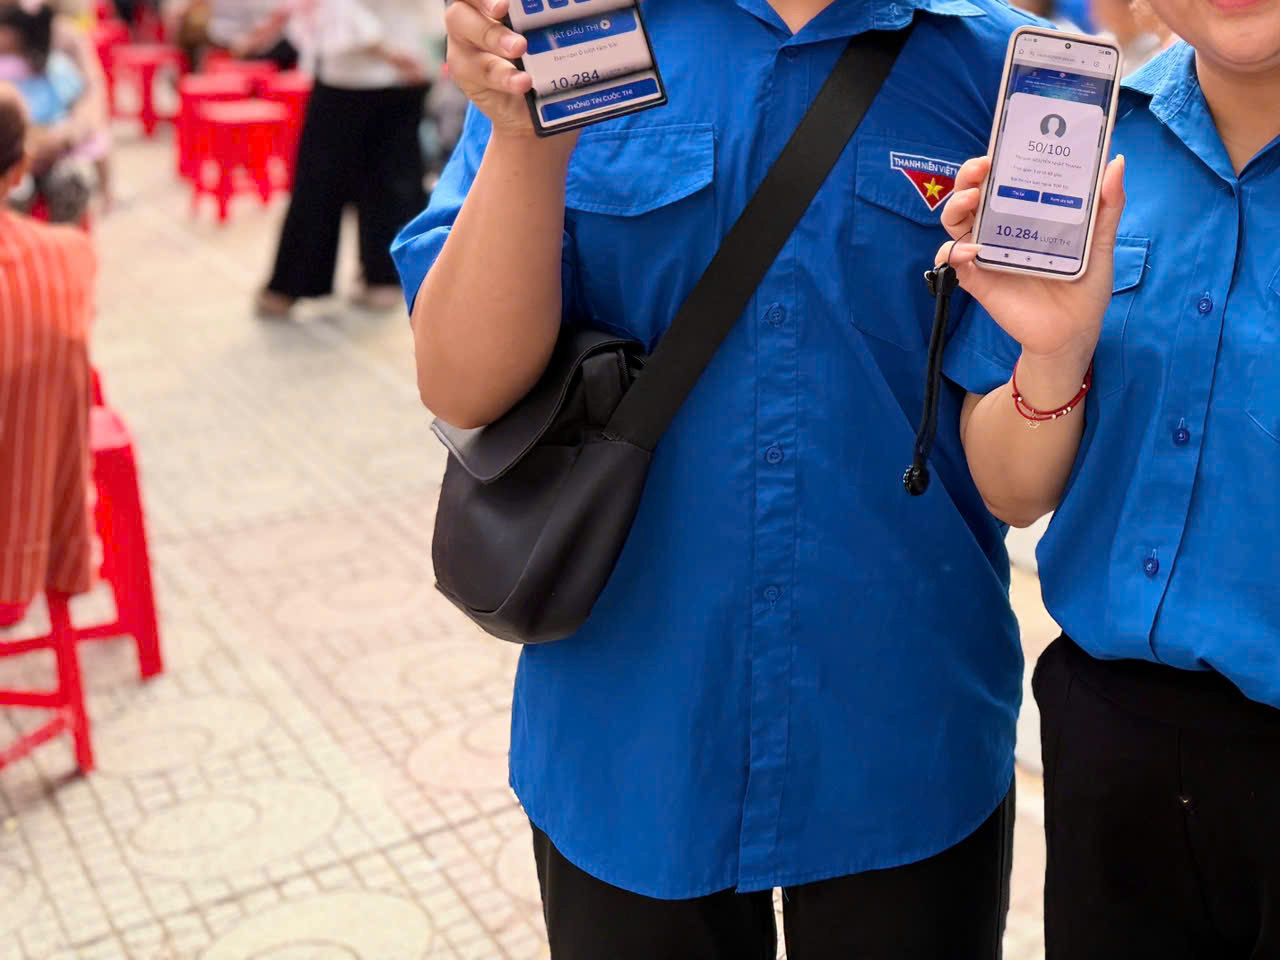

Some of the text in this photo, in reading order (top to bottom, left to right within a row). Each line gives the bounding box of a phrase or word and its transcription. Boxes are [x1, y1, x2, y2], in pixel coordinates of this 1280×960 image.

[550, 69, 600, 91] 10.284
[1027, 140, 1071, 157] 50/100
[894, 157, 920, 169] THANH
[921, 160, 938, 172] NIÊN
[938, 164, 954, 176] VIỆT
[996, 225, 1039, 241] 10.284
